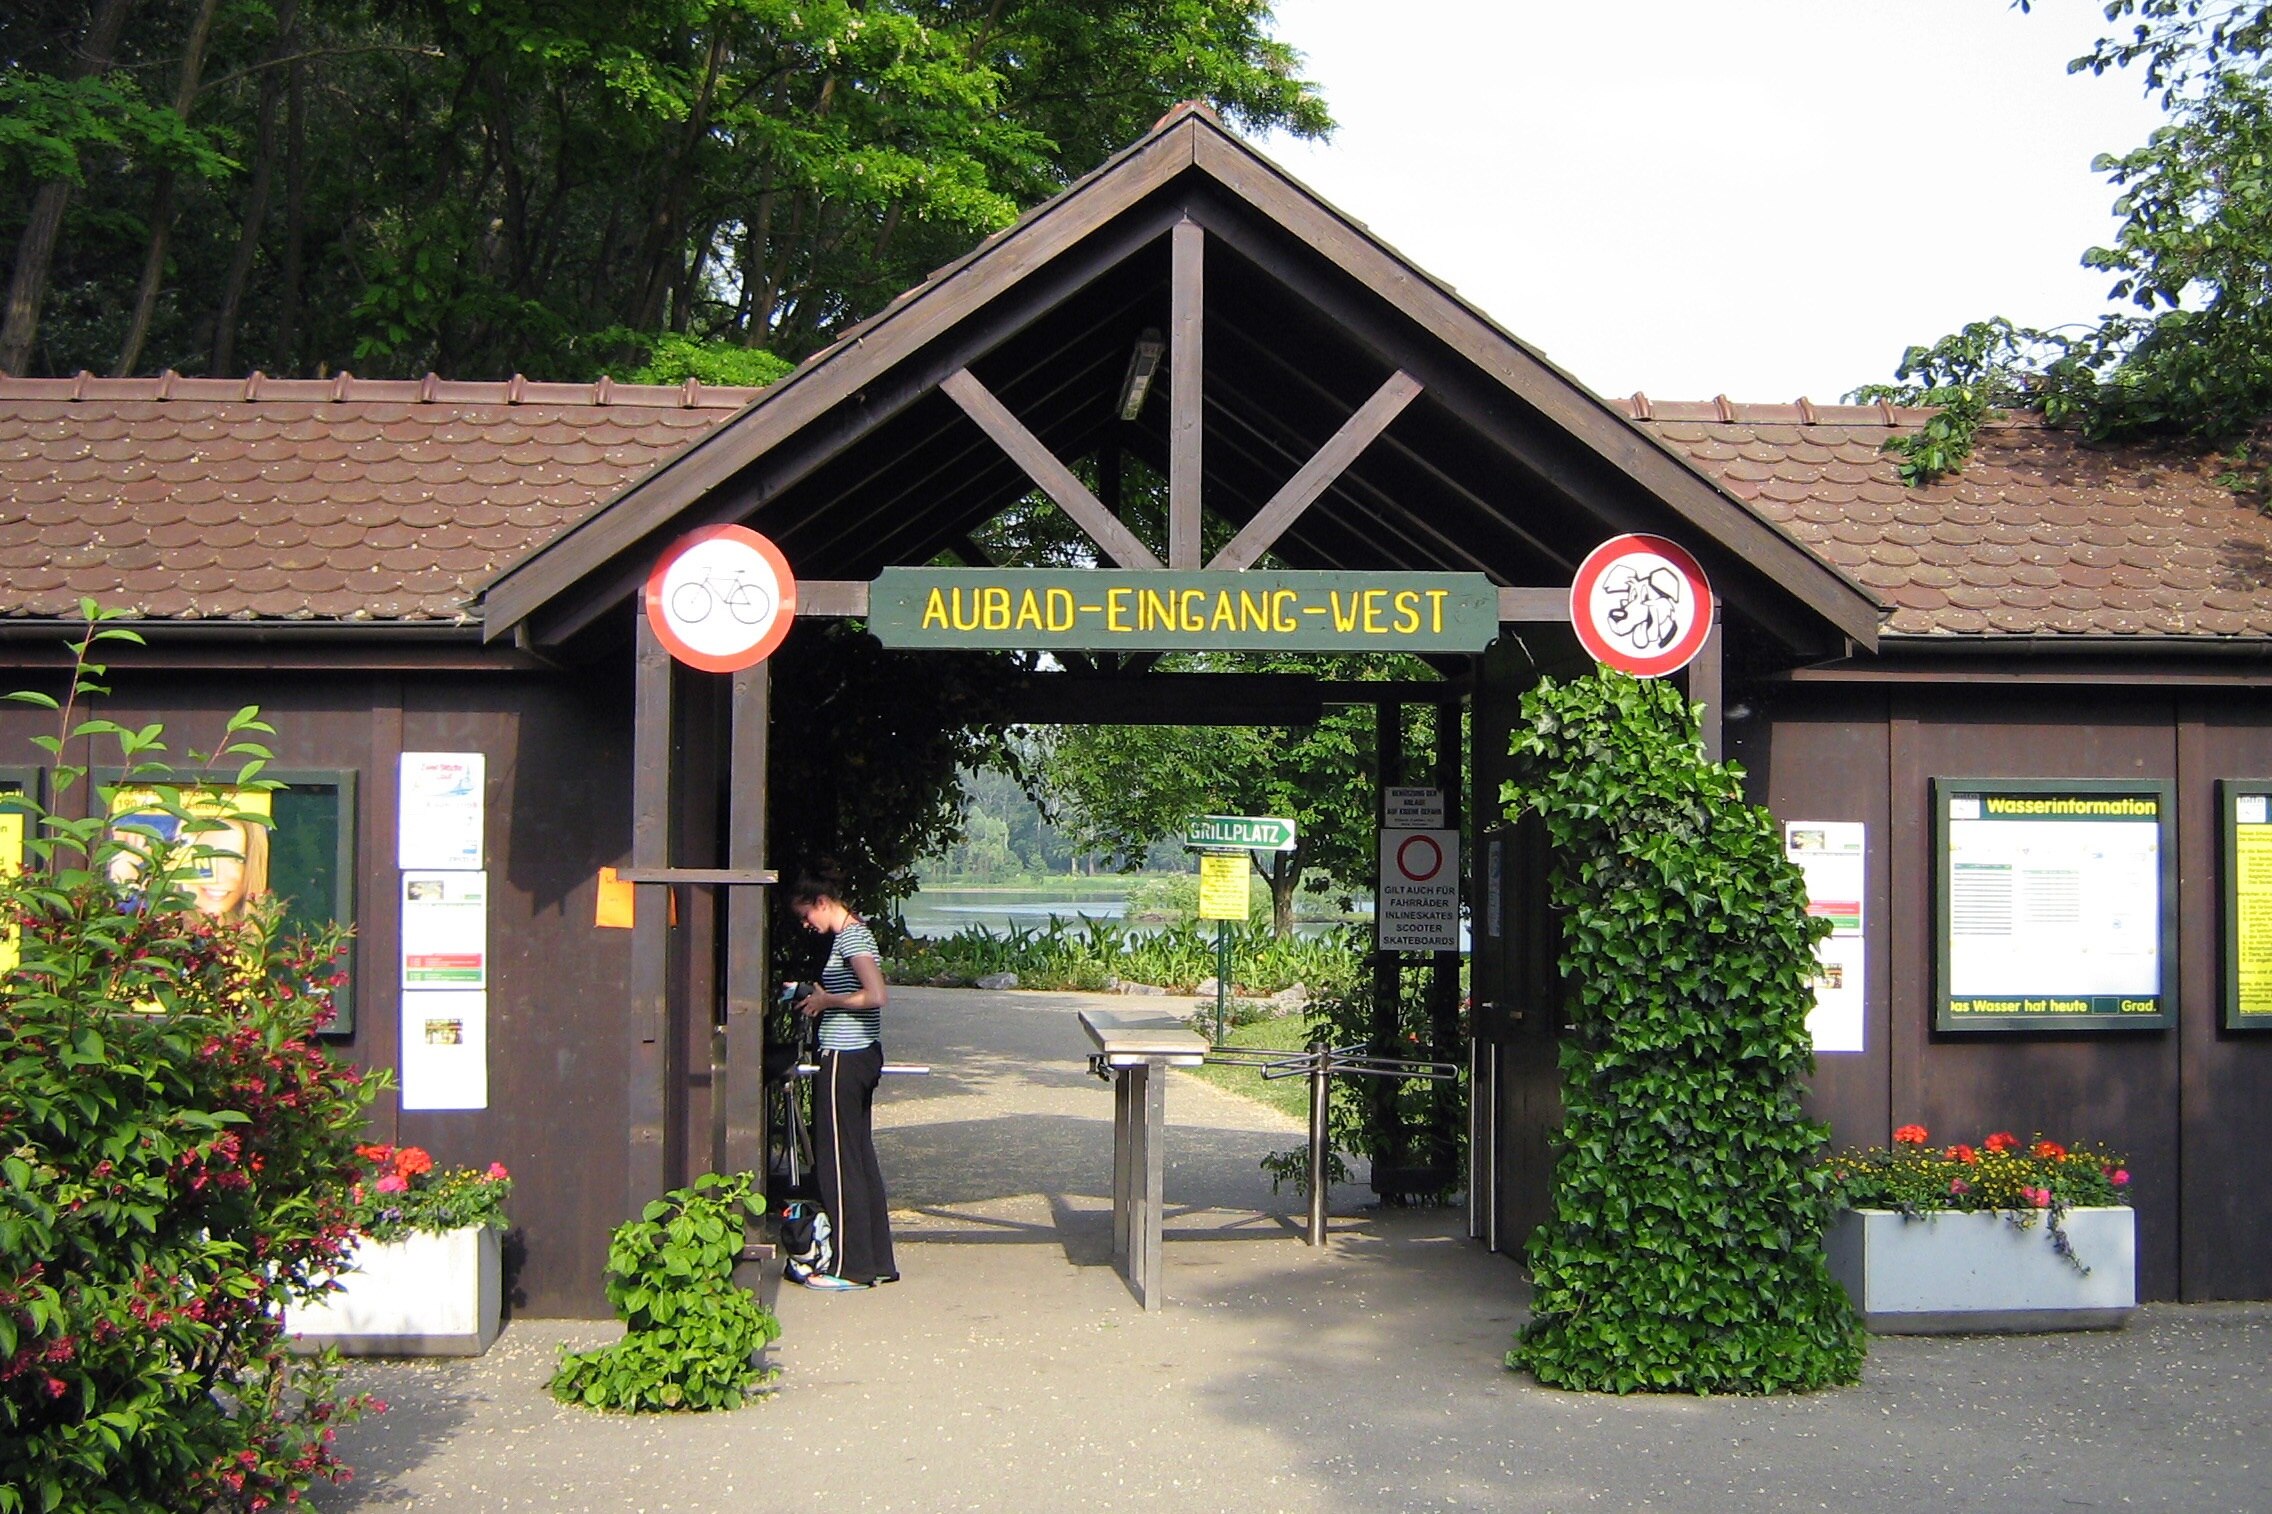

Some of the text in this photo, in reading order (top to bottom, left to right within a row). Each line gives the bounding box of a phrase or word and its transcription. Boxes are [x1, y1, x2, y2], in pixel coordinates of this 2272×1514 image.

[920, 586, 1450, 635] AUBAD-EINGANG-WEST
[1986, 797, 2157, 816] Wasserinformation
[1190, 821, 1280, 843] GRILLPLATZ
[1384, 885, 1456, 895] GILT AUCH FÜR
[1390, 897, 1449, 908] FAHRRÄDER
[1385, 911, 1453, 920] INLINESKATES
[1395, 923, 1443, 933] SCOOTER
[1383, 935, 1455, 945] SKATEBOARDS
[1973, 999, 2021, 1012] Wasser
[2024, 998, 2047, 1012] hat
[2050, 999, 2087, 1012] heute
[2121, 999, 2157, 1012] Grad.
